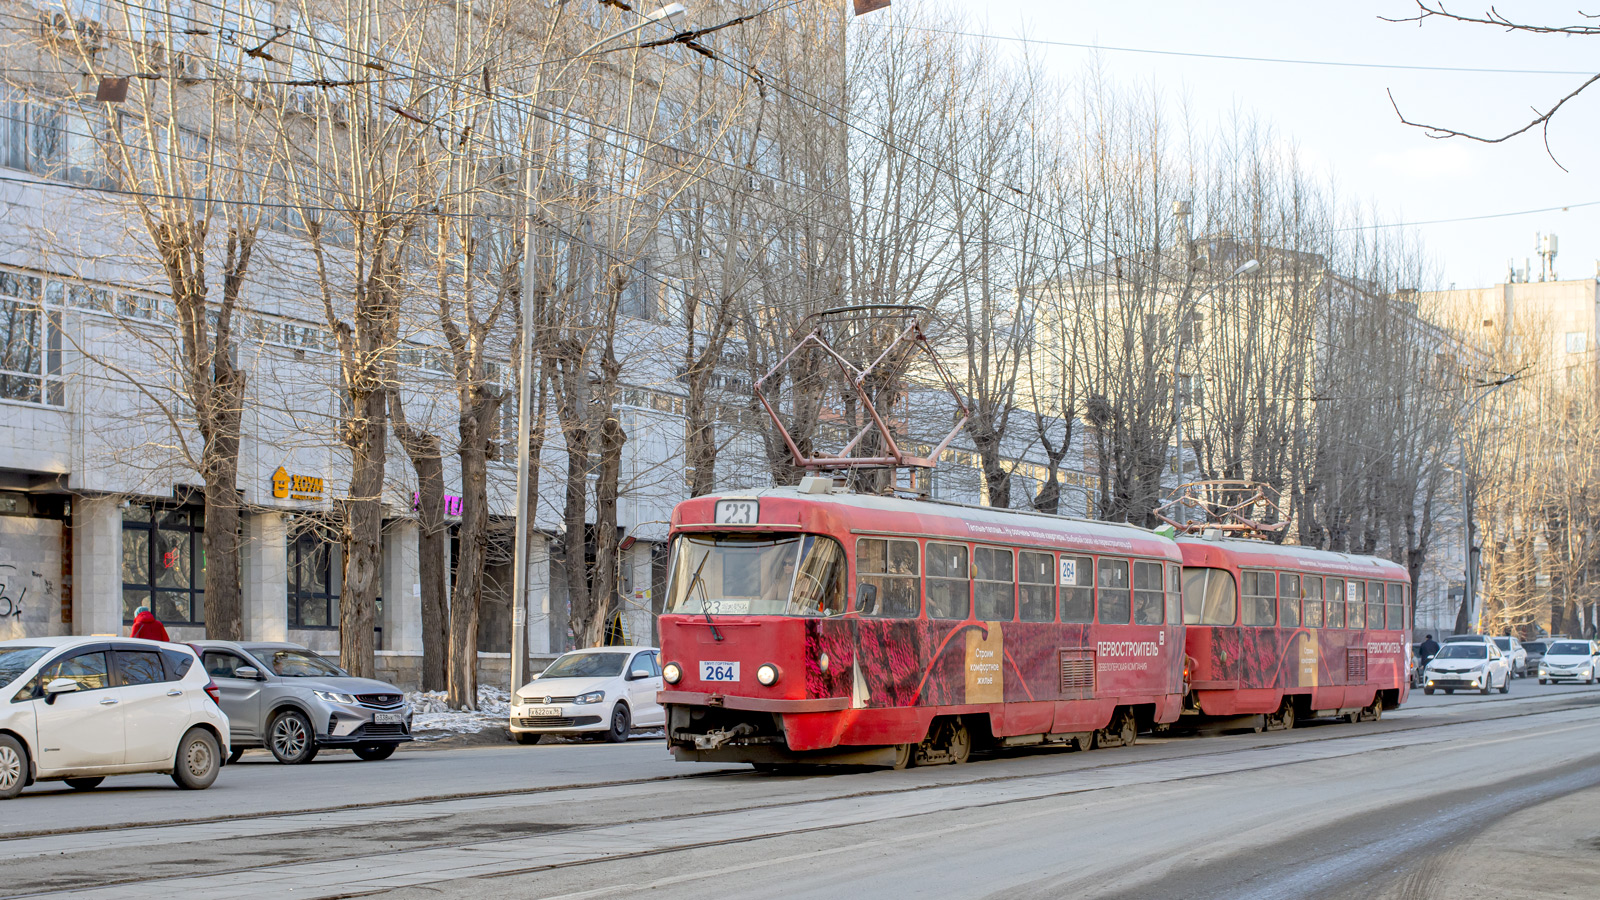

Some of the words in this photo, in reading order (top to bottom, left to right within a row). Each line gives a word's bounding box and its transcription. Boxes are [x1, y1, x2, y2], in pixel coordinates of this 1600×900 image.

[291, 474, 324, 493] ХОУМ
[725, 503, 752, 524] 23
[1063, 562, 1075, 578] 264
[702, 600, 721, 614] 23
[975, 647, 994, 660] Строим
[1097, 641, 1159, 657] ПЕРВОСТРОИТЕЛЬ
[705, 665, 734, 681] 264
[970, 661, 999, 674] комфортное
[977, 673, 993, 685] жильё
